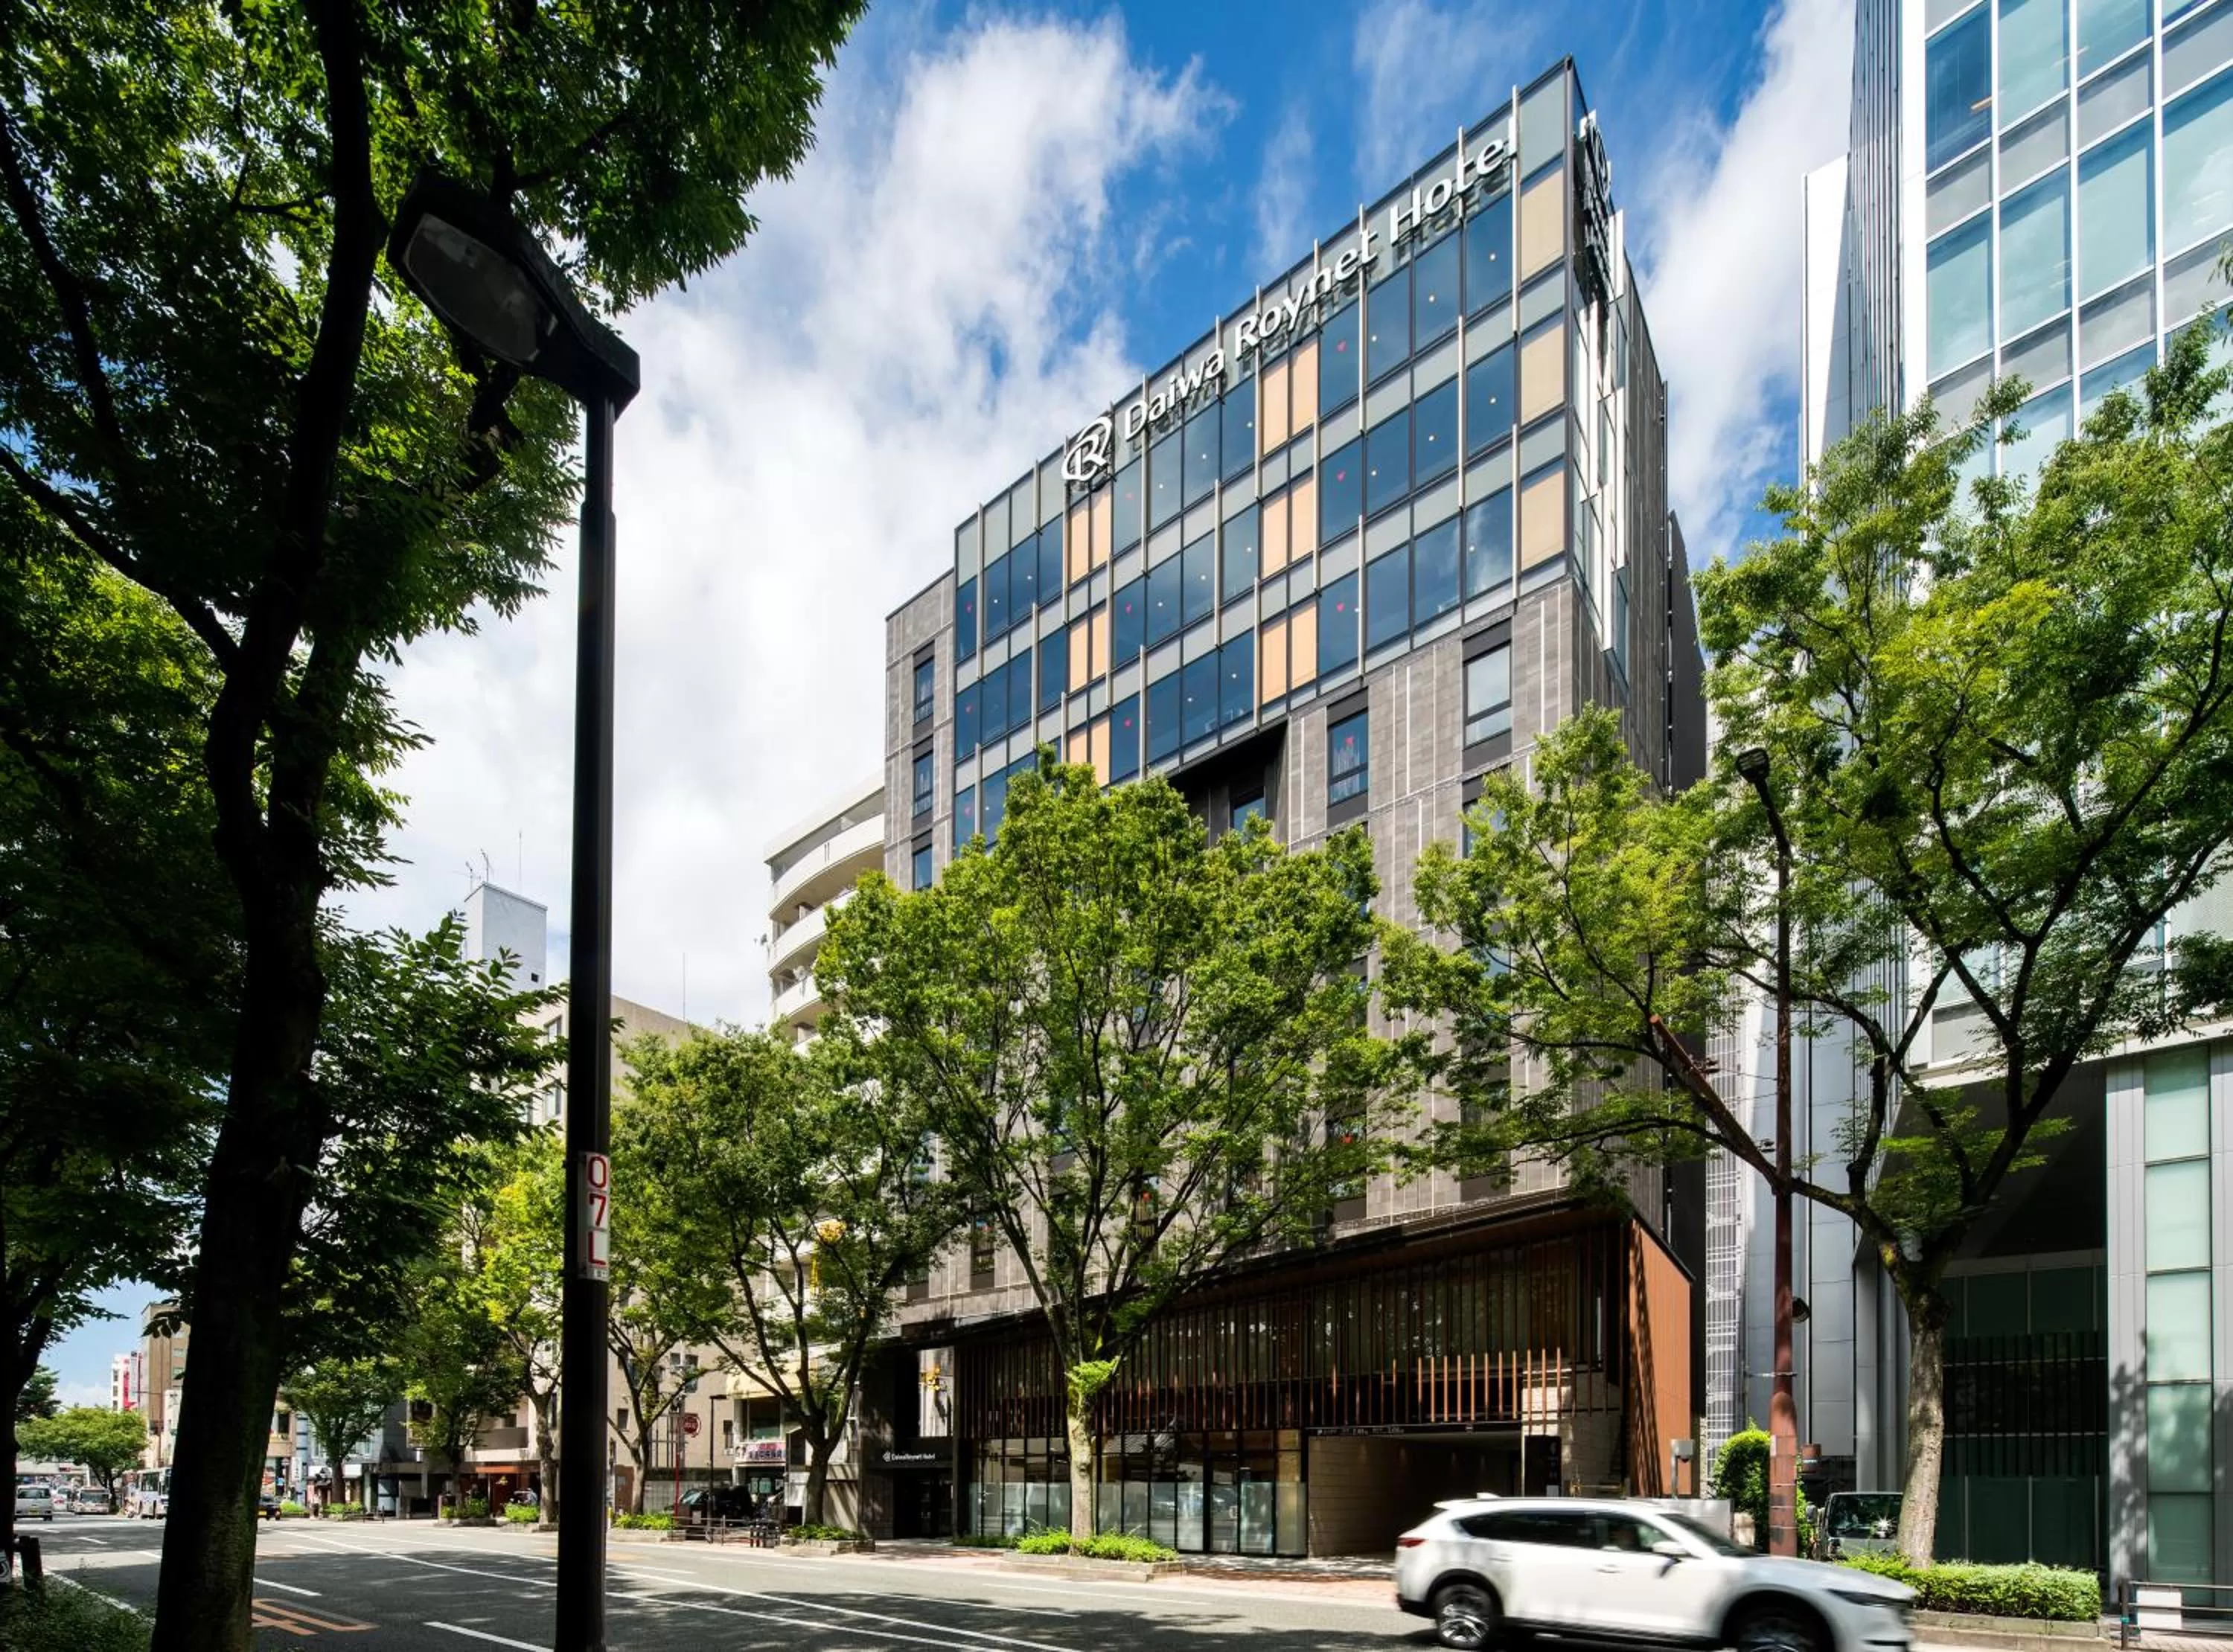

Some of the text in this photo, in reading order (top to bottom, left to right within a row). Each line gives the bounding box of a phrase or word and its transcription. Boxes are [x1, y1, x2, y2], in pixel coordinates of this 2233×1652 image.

[1125, 348, 1225, 442] Daiwa
[1235, 228, 1378, 360] Roynet
[1390, 115, 1517, 246] Hotel
